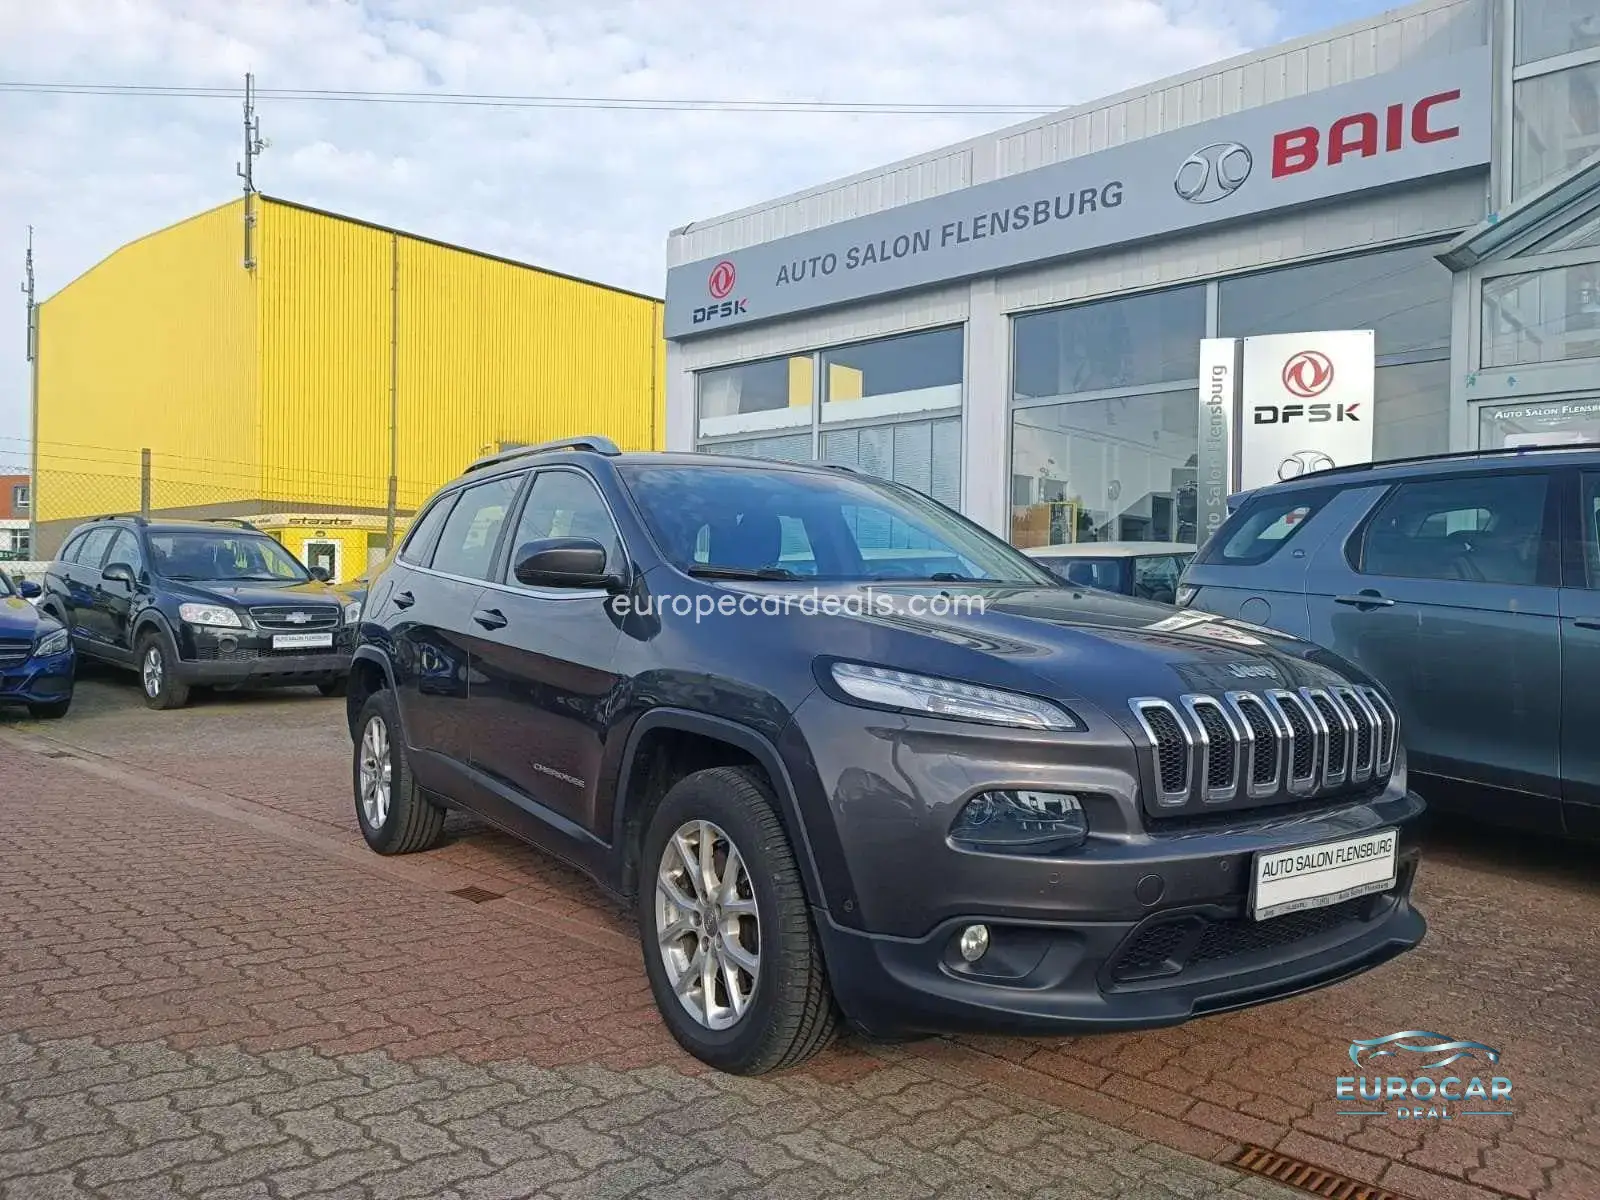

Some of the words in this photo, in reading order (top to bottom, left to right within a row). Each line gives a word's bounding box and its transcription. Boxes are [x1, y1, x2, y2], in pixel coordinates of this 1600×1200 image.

[1272, 89, 1461, 179] BAIC
[776, 253, 837, 286] AUTO
[845, 229, 930, 270] SALON
[940, 180, 1124, 247] FLENSBURG
[693, 299, 748, 324] DFSK
[1254, 402, 1361, 425] DFSK
[1262, 858, 1293, 877] AUTO
[1296, 851, 1333, 871] SALON
[1336, 839, 1392, 863] FLENSBURG
